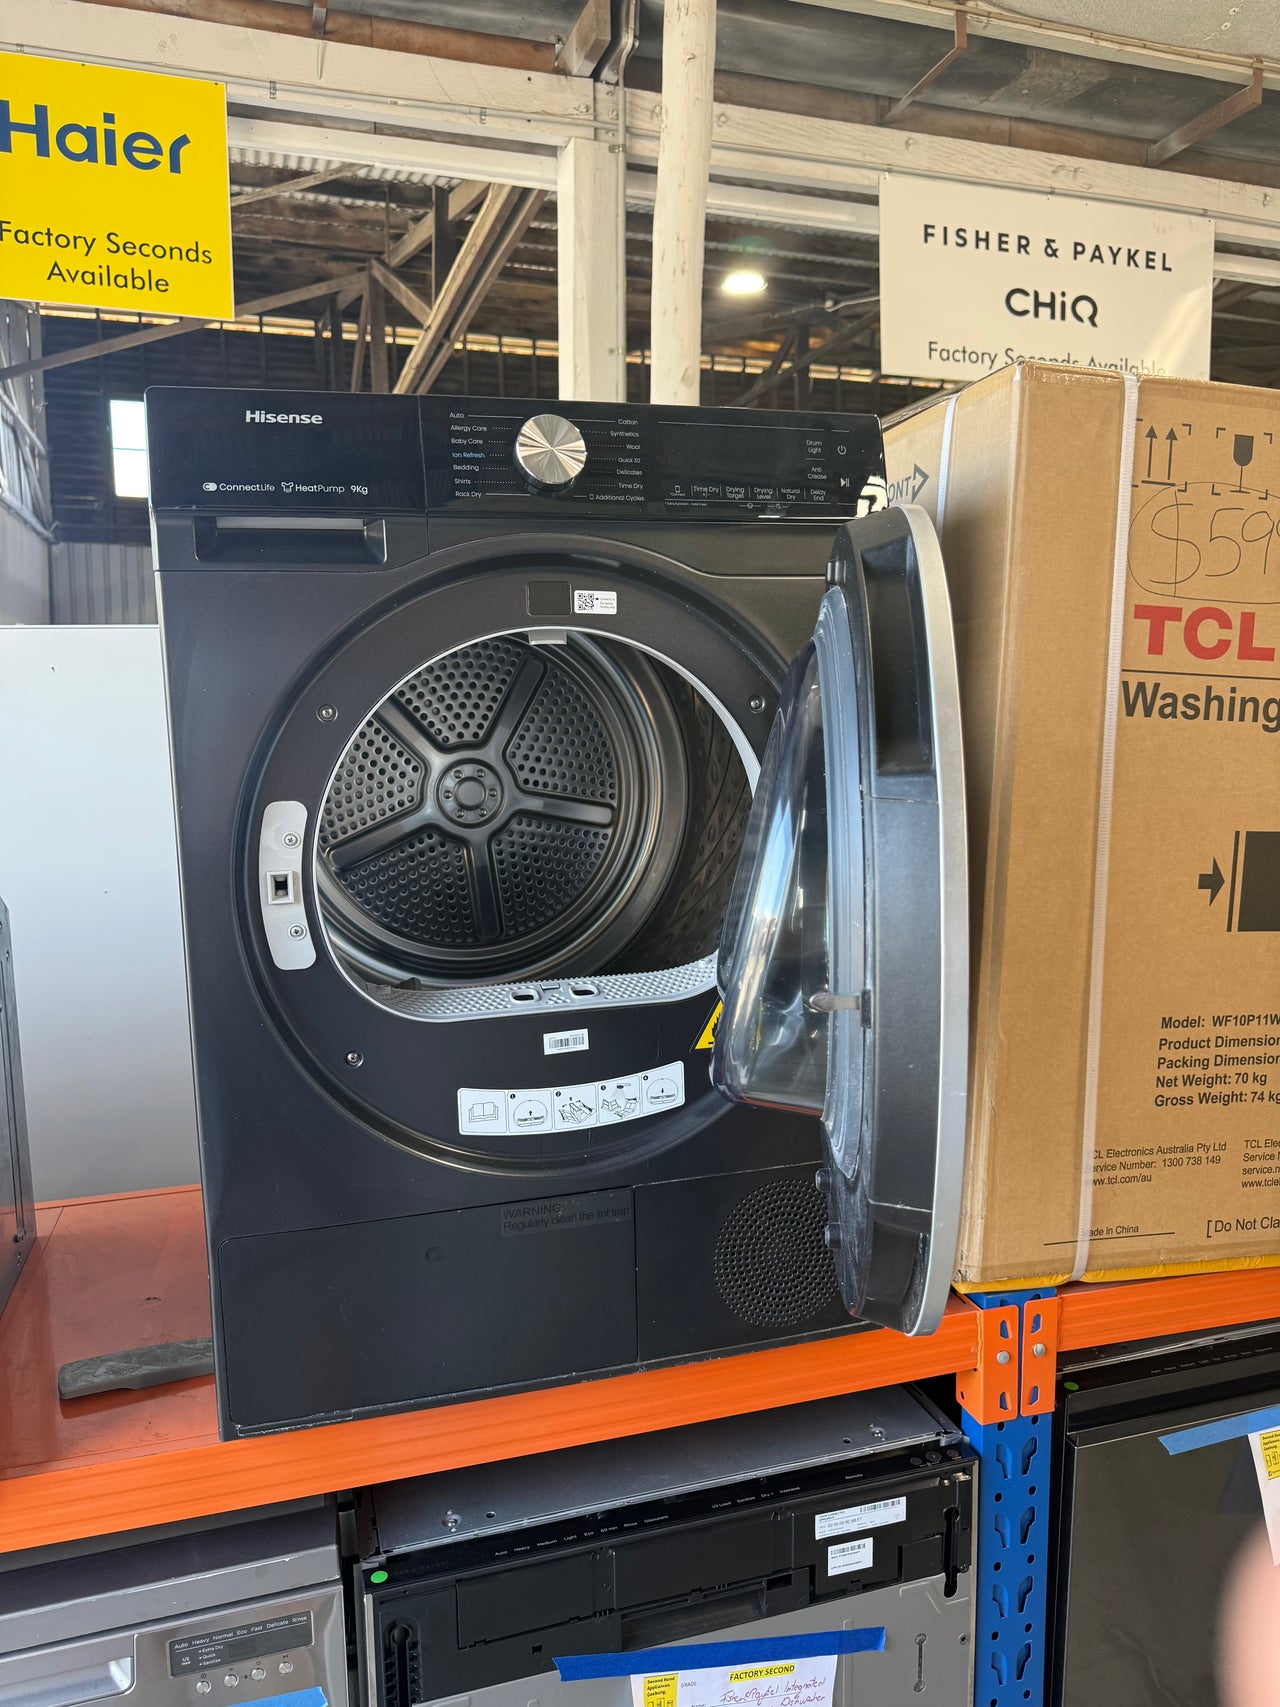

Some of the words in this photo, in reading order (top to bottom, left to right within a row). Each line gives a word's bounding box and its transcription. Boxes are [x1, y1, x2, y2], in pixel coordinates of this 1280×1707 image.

[0, 100, 191, 175] Haier
[0, 220, 96, 256] Factory
[106, 231, 213, 264] Seconds
[923, 223, 1031, 256] FISHER
[1044, 238, 1059, 259] &
[1073, 241, 1173, 272] PAYKEL
[46, 260, 170, 294] Available
[1005, 288, 1099, 328] CHiQ
[928, 341, 998, 370] Factory
[245, 410, 323, 424] Hisense
[450, 425, 471, 433] Allergy
[610, 430, 639, 438] Synthetics
[451, 438, 467, 446] Baby
[453, 464, 479, 472] Bedding
[219, 482, 276, 492] ConnectLife
[295, 483, 346, 494] HeatPump
[350, 484, 369, 496] 9Kg
[471, 491, 482, 499] Dry
[709, 486, 719, 494] Dry
[726, 486, 744, 494] Drying
[754, 487, 773, 495] Drying
[888, 475, 911, 502] ONT
[1149, 490, 1280, 598] $59
[1134, 604, 1276, 662] TCL
[1122, 680, 1280, 733] Washing
[1161, 1016, 1205, 1029] Model:
[1159, 1037, 1210, 1050] Product
[1157, 1056, 1210, 1070] Packing
[1156, 1076, 1178, 1088] Net
[1182, 1073, 1231, 1089] Weight:
[1234, 1072, 1249, 1084] 70
[1252, 1072, 1267, 1086] kg
[1154, 1094, 1194, 1107] Gross
[1198, 1091, 1248, 1106] Weight:
[1251, 1091, 1265, 1103] 74
[1268, 1090, 1280, 1104] kg
[1094, 1150, 1104, 1159] CL
[1106, 1147, 1154, 1158] Electronics
[1156, 1143, 1194, 1155] Australia
[1197, 1143, 1210, 1154] Pty
[1213, 1142, 1227, 1151] Ltd
[1244, 1139, 1262, 1149] TCL
[1119, 1160, 1157, 1171] Number:
[1162, 1158, 1184, 1168] 1300
[1186, 1156, 1202, 1166] 738
[1206, 1155, 1221, 1165] 149
[1243, 1151, 1275, 1162] Service
[1092, 1173, 1152, 1186] ww.tcl.com/au
[503, 1218, 548, 1232] Regularly
[551, 1214, 577, 1225] clean
[579, 1210, 594, 1220] the
[597, 1209, 609, 1218] lint
[612, 1206, 629, 1218] trap
[1236, 1218, 1257, 1231] Not
[1260, 1216, 1280, 1229] Cla
[1089, 1227, 1104, 1237] ade
[1115, 1225, 1139, 1234] China
[536, 1539, 558, 1547] Medium
[174, 1642, 189, 1650] Auto
[192, 1637, 209, 1646] Heavy
[213, 1632, 234, 1641] Normal
[266, 1620, 289, 1629] Delicate
[730, 1670, 764, 1681] FACTORY
[765, 1665, 795, 1676] SECOND
